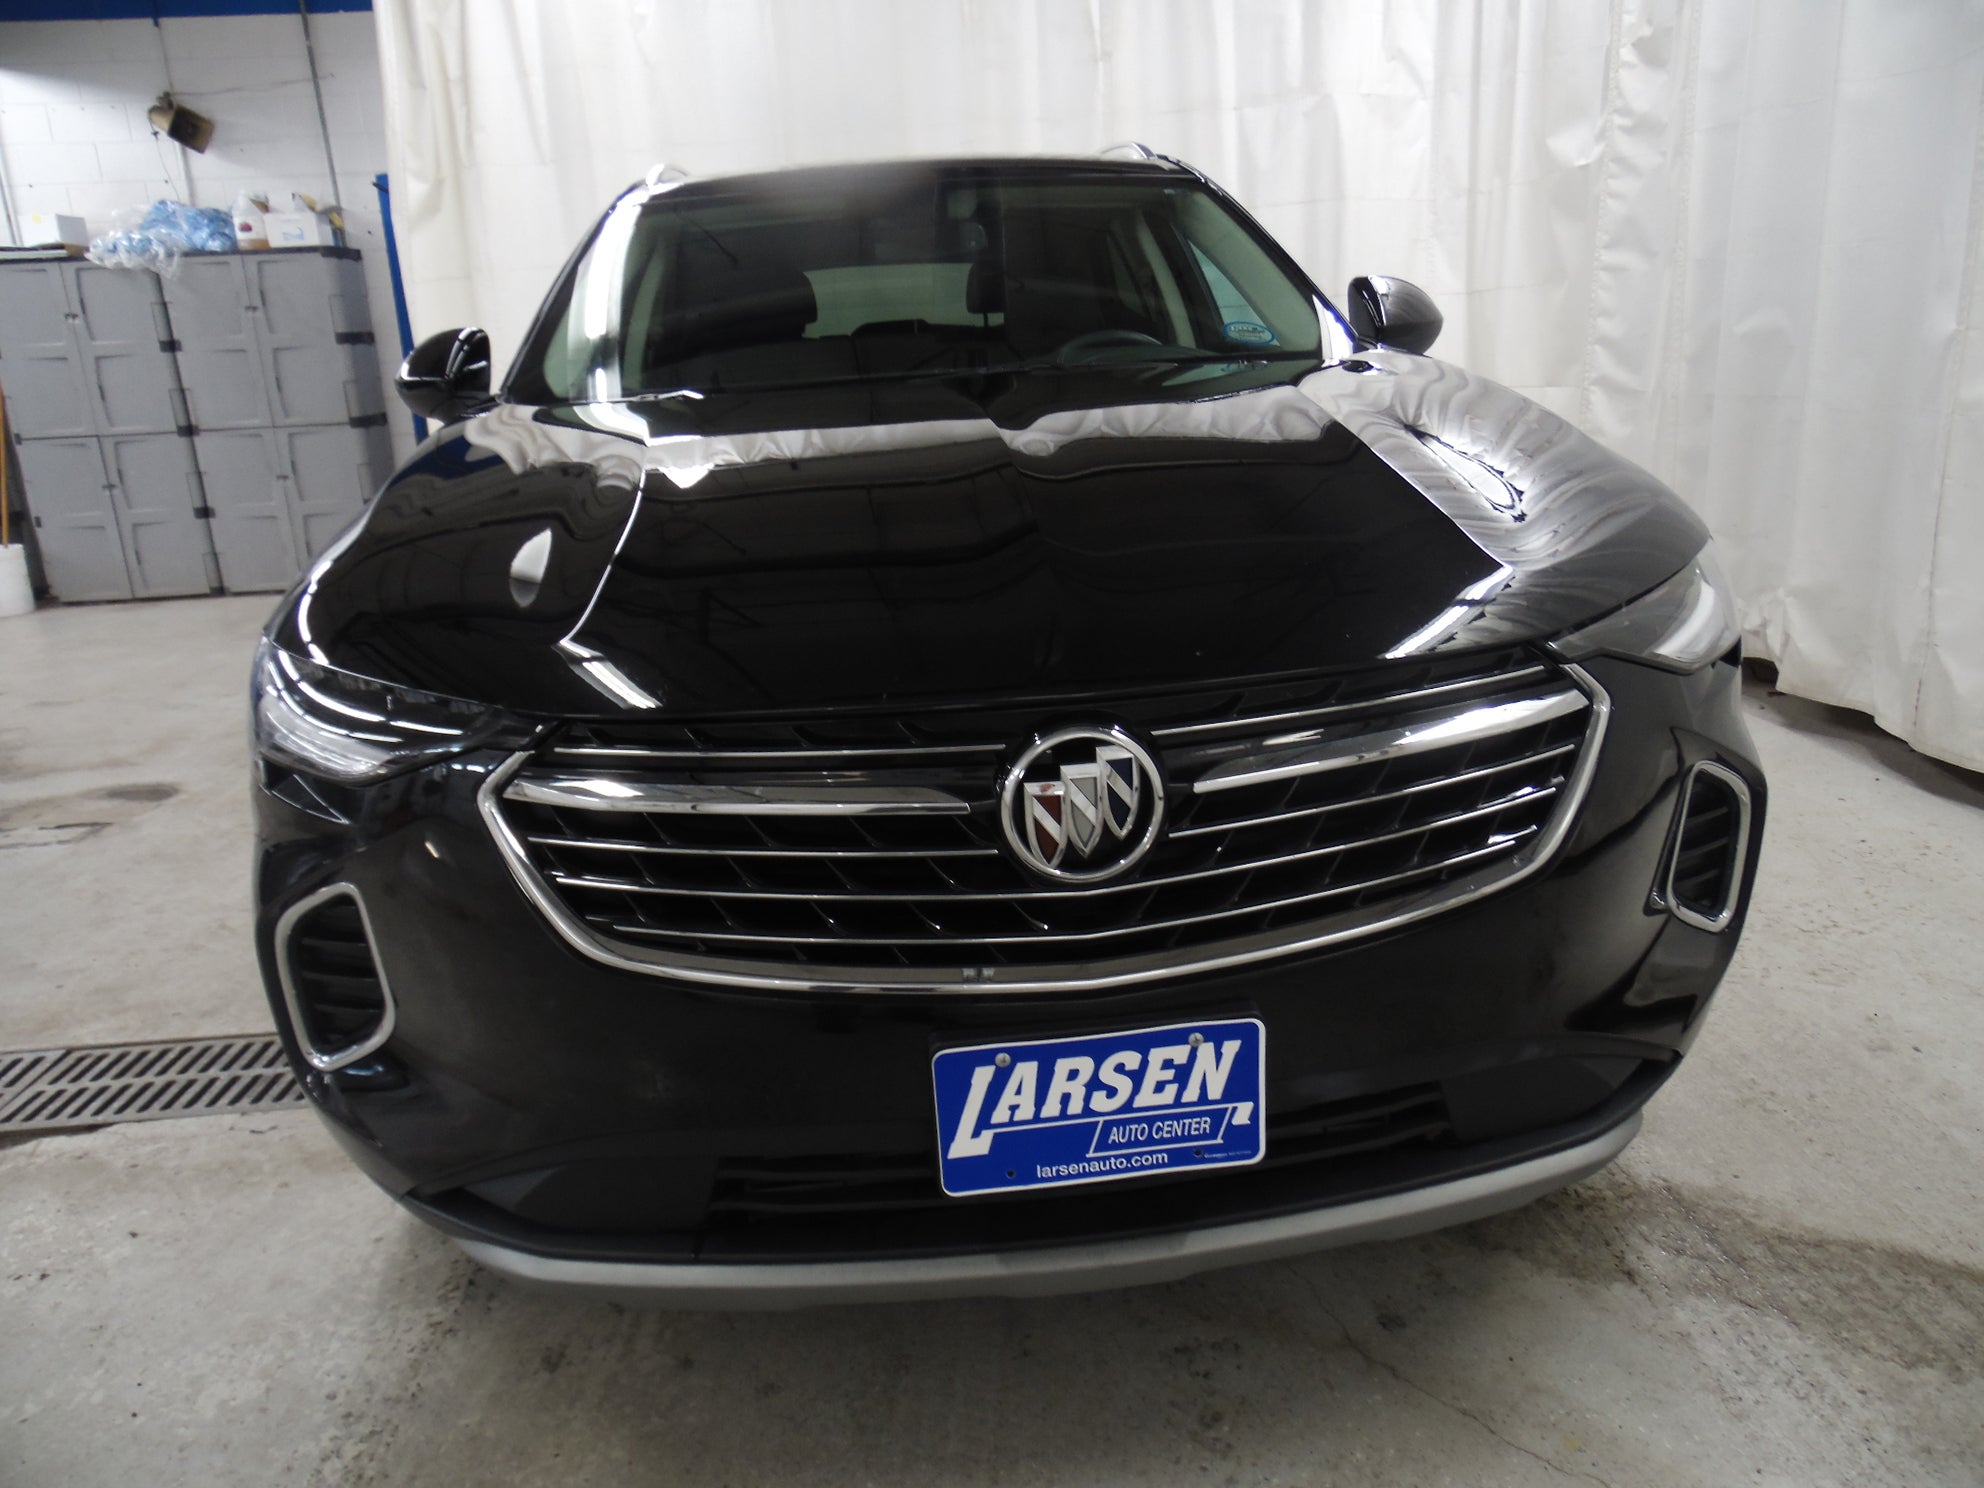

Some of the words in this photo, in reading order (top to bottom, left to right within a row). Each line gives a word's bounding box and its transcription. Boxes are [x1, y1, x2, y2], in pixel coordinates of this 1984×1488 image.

[947, 1039, 1242, 1159] LARSEN
[1108, 1123, 1148, 1144] AUTO
[1152, 1116, 1210, 1139] CENTER
[1036, 1151, 1168, 1178] larsenauto.com
